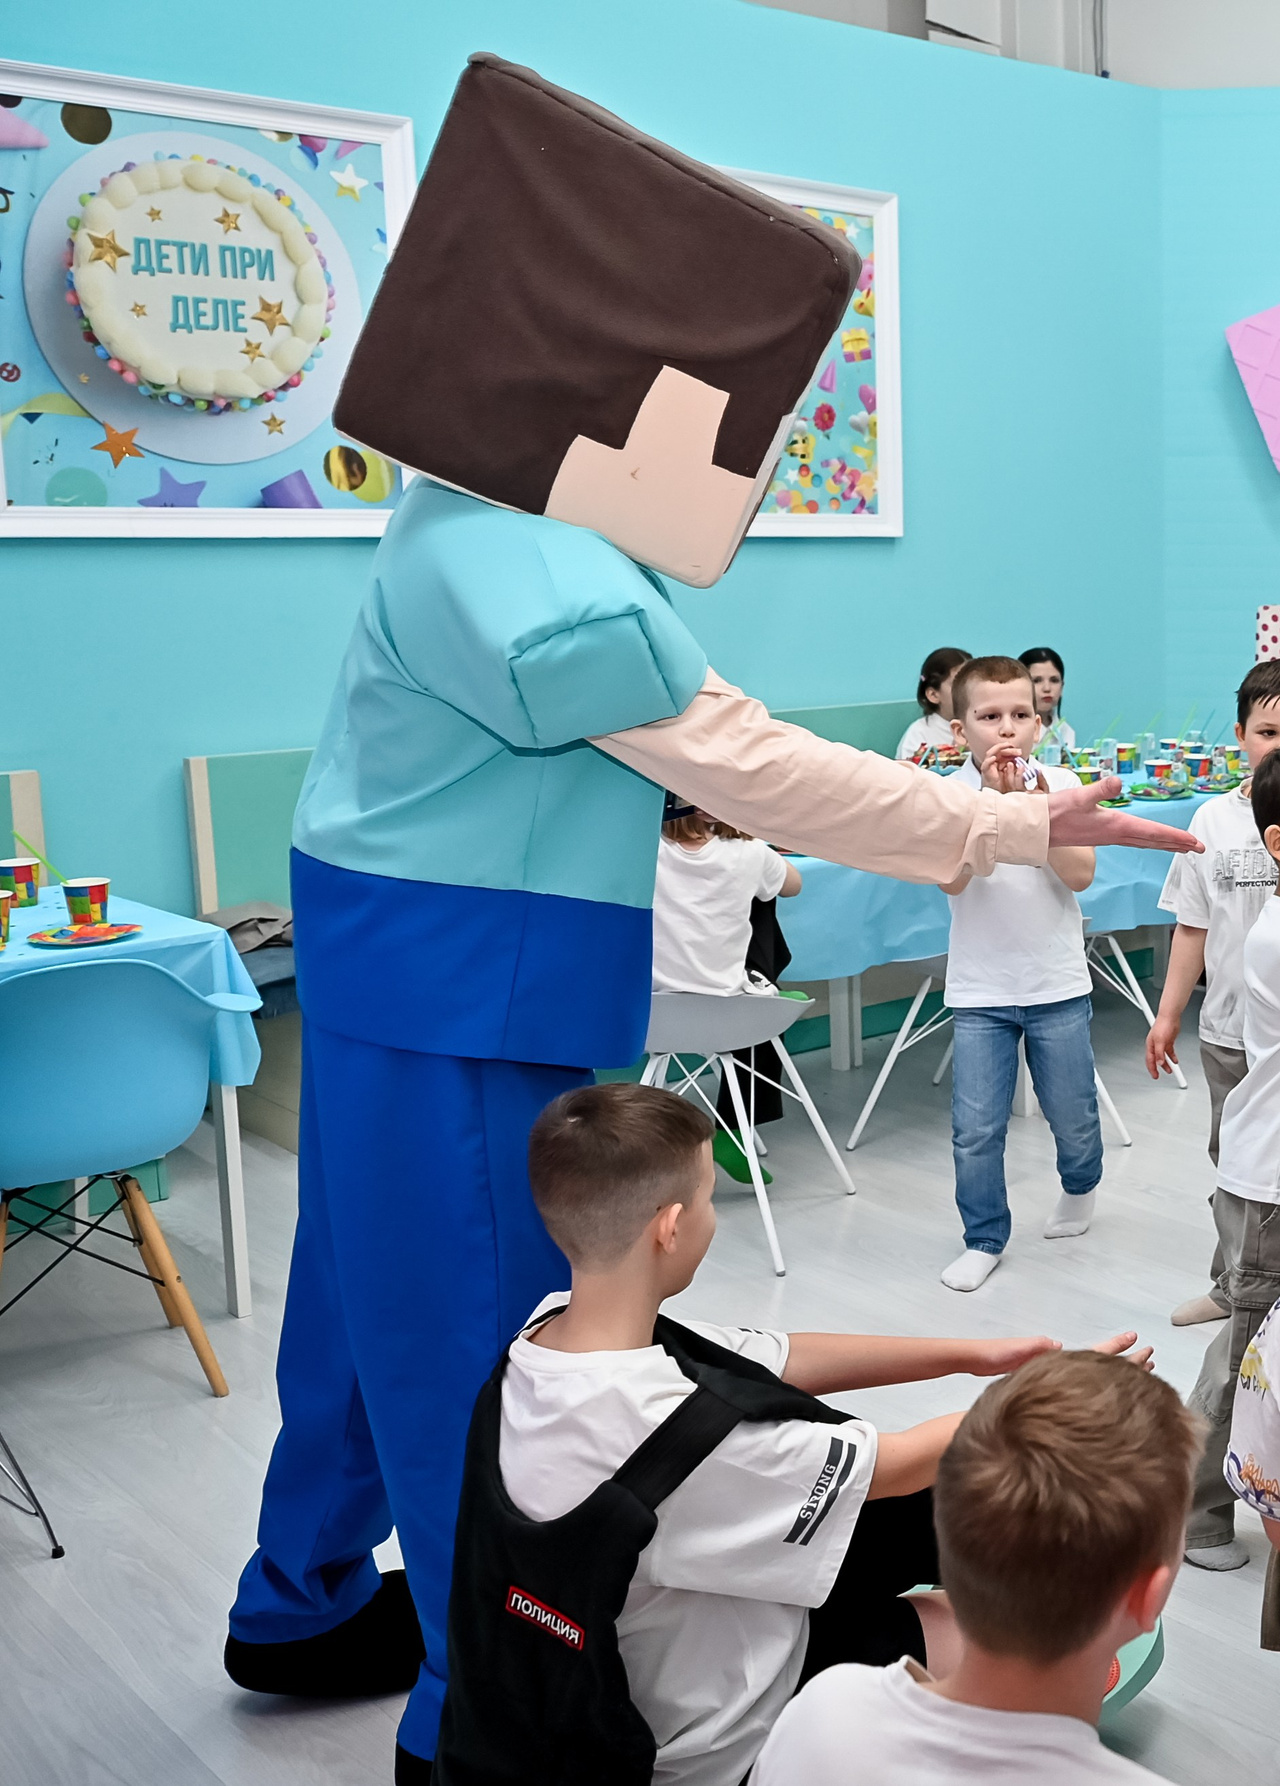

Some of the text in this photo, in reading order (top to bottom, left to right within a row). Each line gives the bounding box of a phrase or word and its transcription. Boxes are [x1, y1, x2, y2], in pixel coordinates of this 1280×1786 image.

[131, 237, 275, 282] ДЕТИ ПРИ
[170, 295, 248, 334] ДЕЛЕ
[800, 1464, 836, 1520] STRONG
[510, 1592, 580, 1645] ПОЛИЦИЯ
